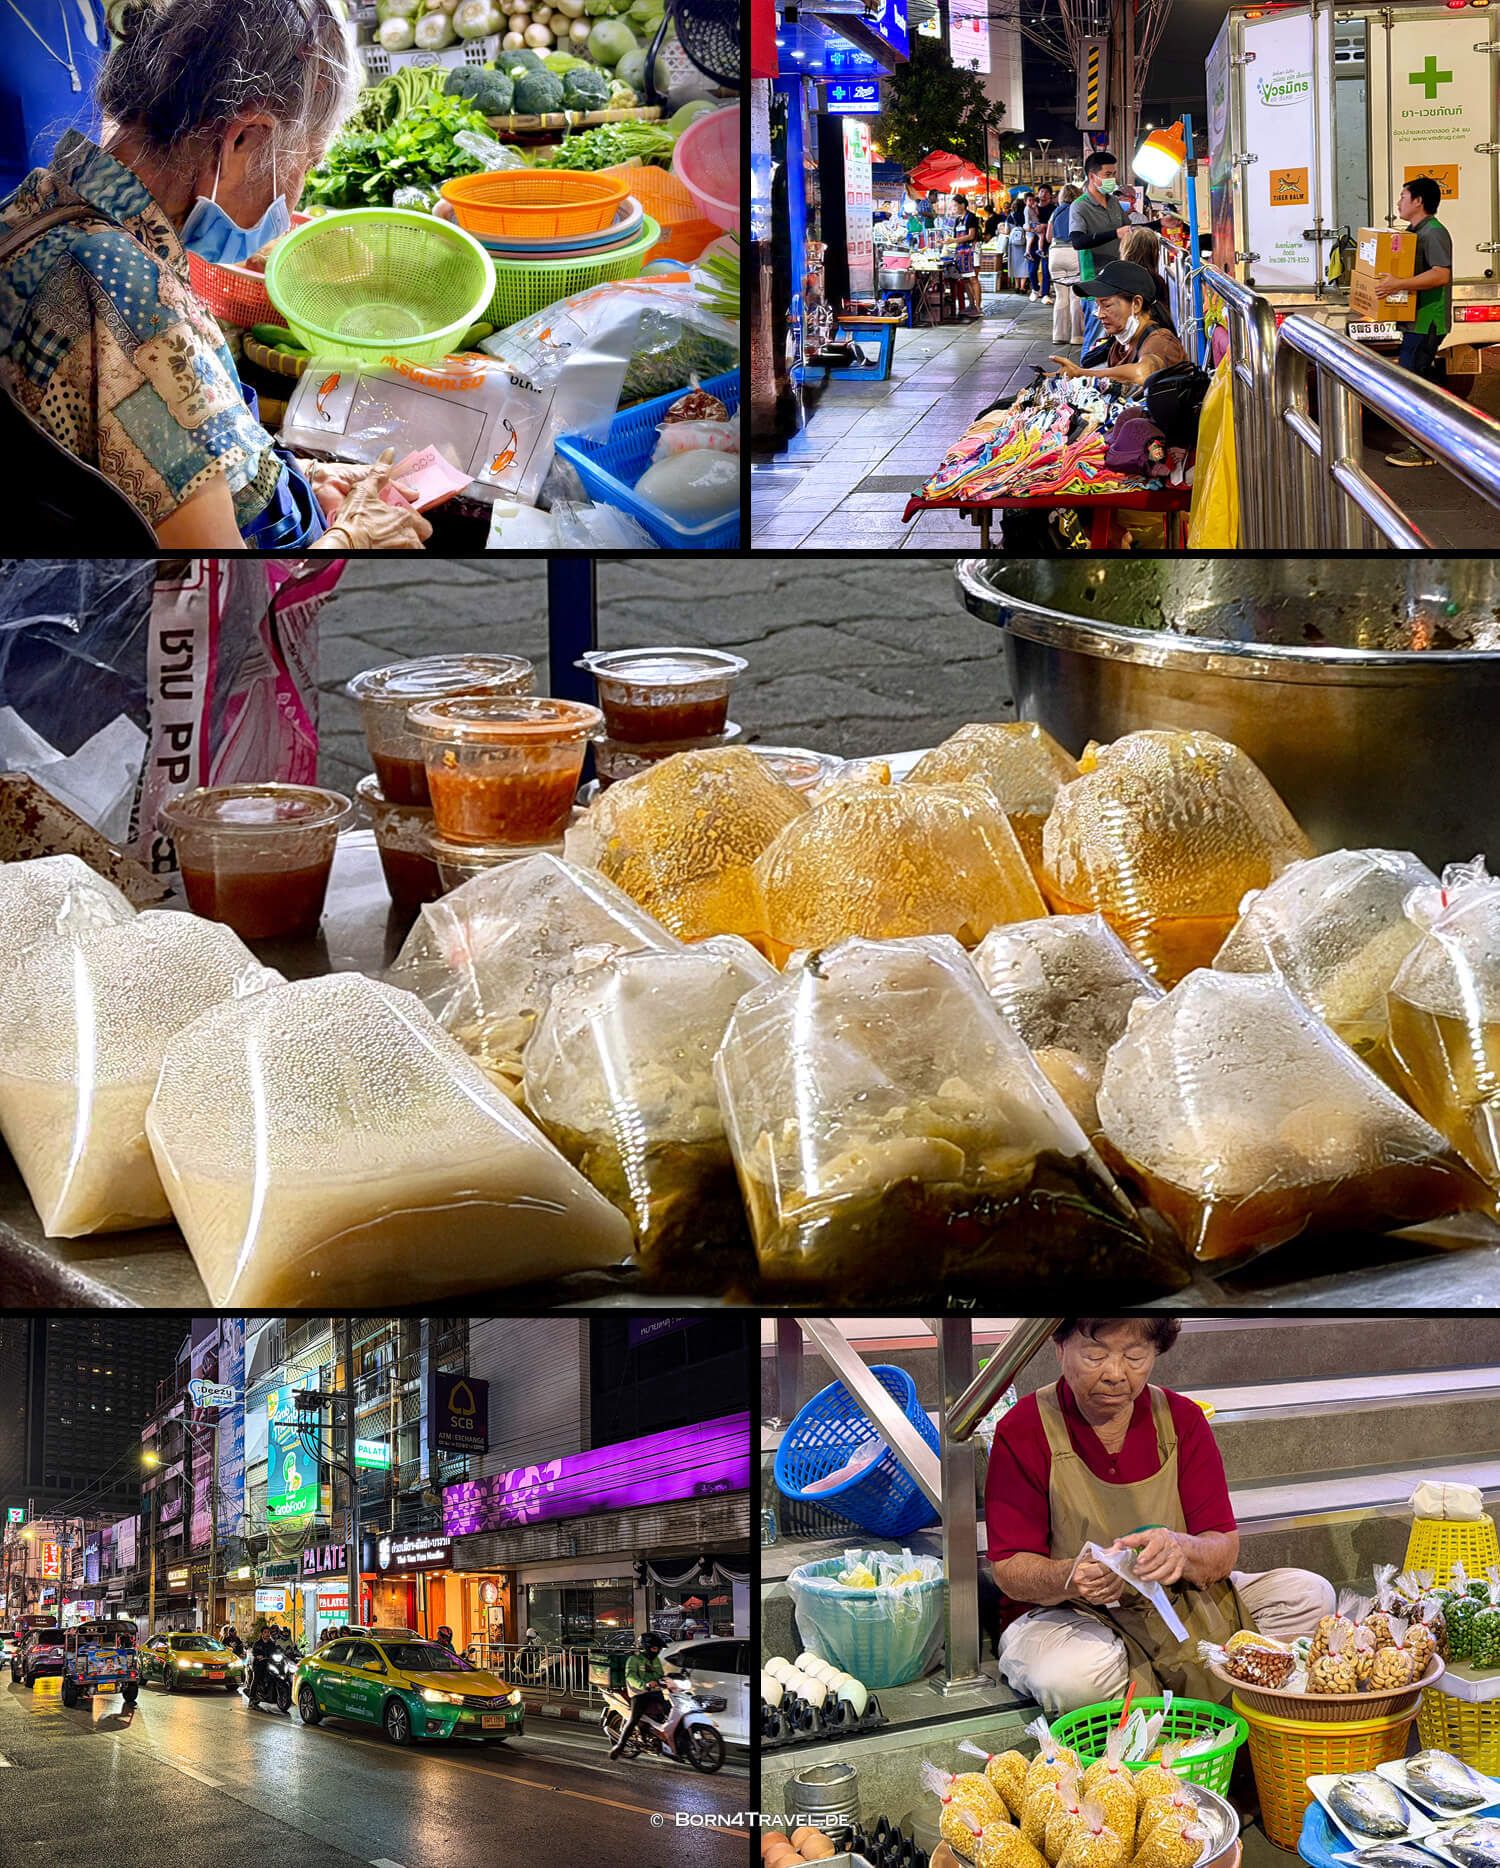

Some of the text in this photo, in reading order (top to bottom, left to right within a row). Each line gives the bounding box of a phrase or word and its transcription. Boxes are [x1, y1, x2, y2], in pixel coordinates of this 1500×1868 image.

[157, 629, 195, 785] ชาม PP
[450, 1416, 474, 1430] SCB
[438, 1432, 452, 1441] ATM
[304, 1544, 346, 1572] PALATE
